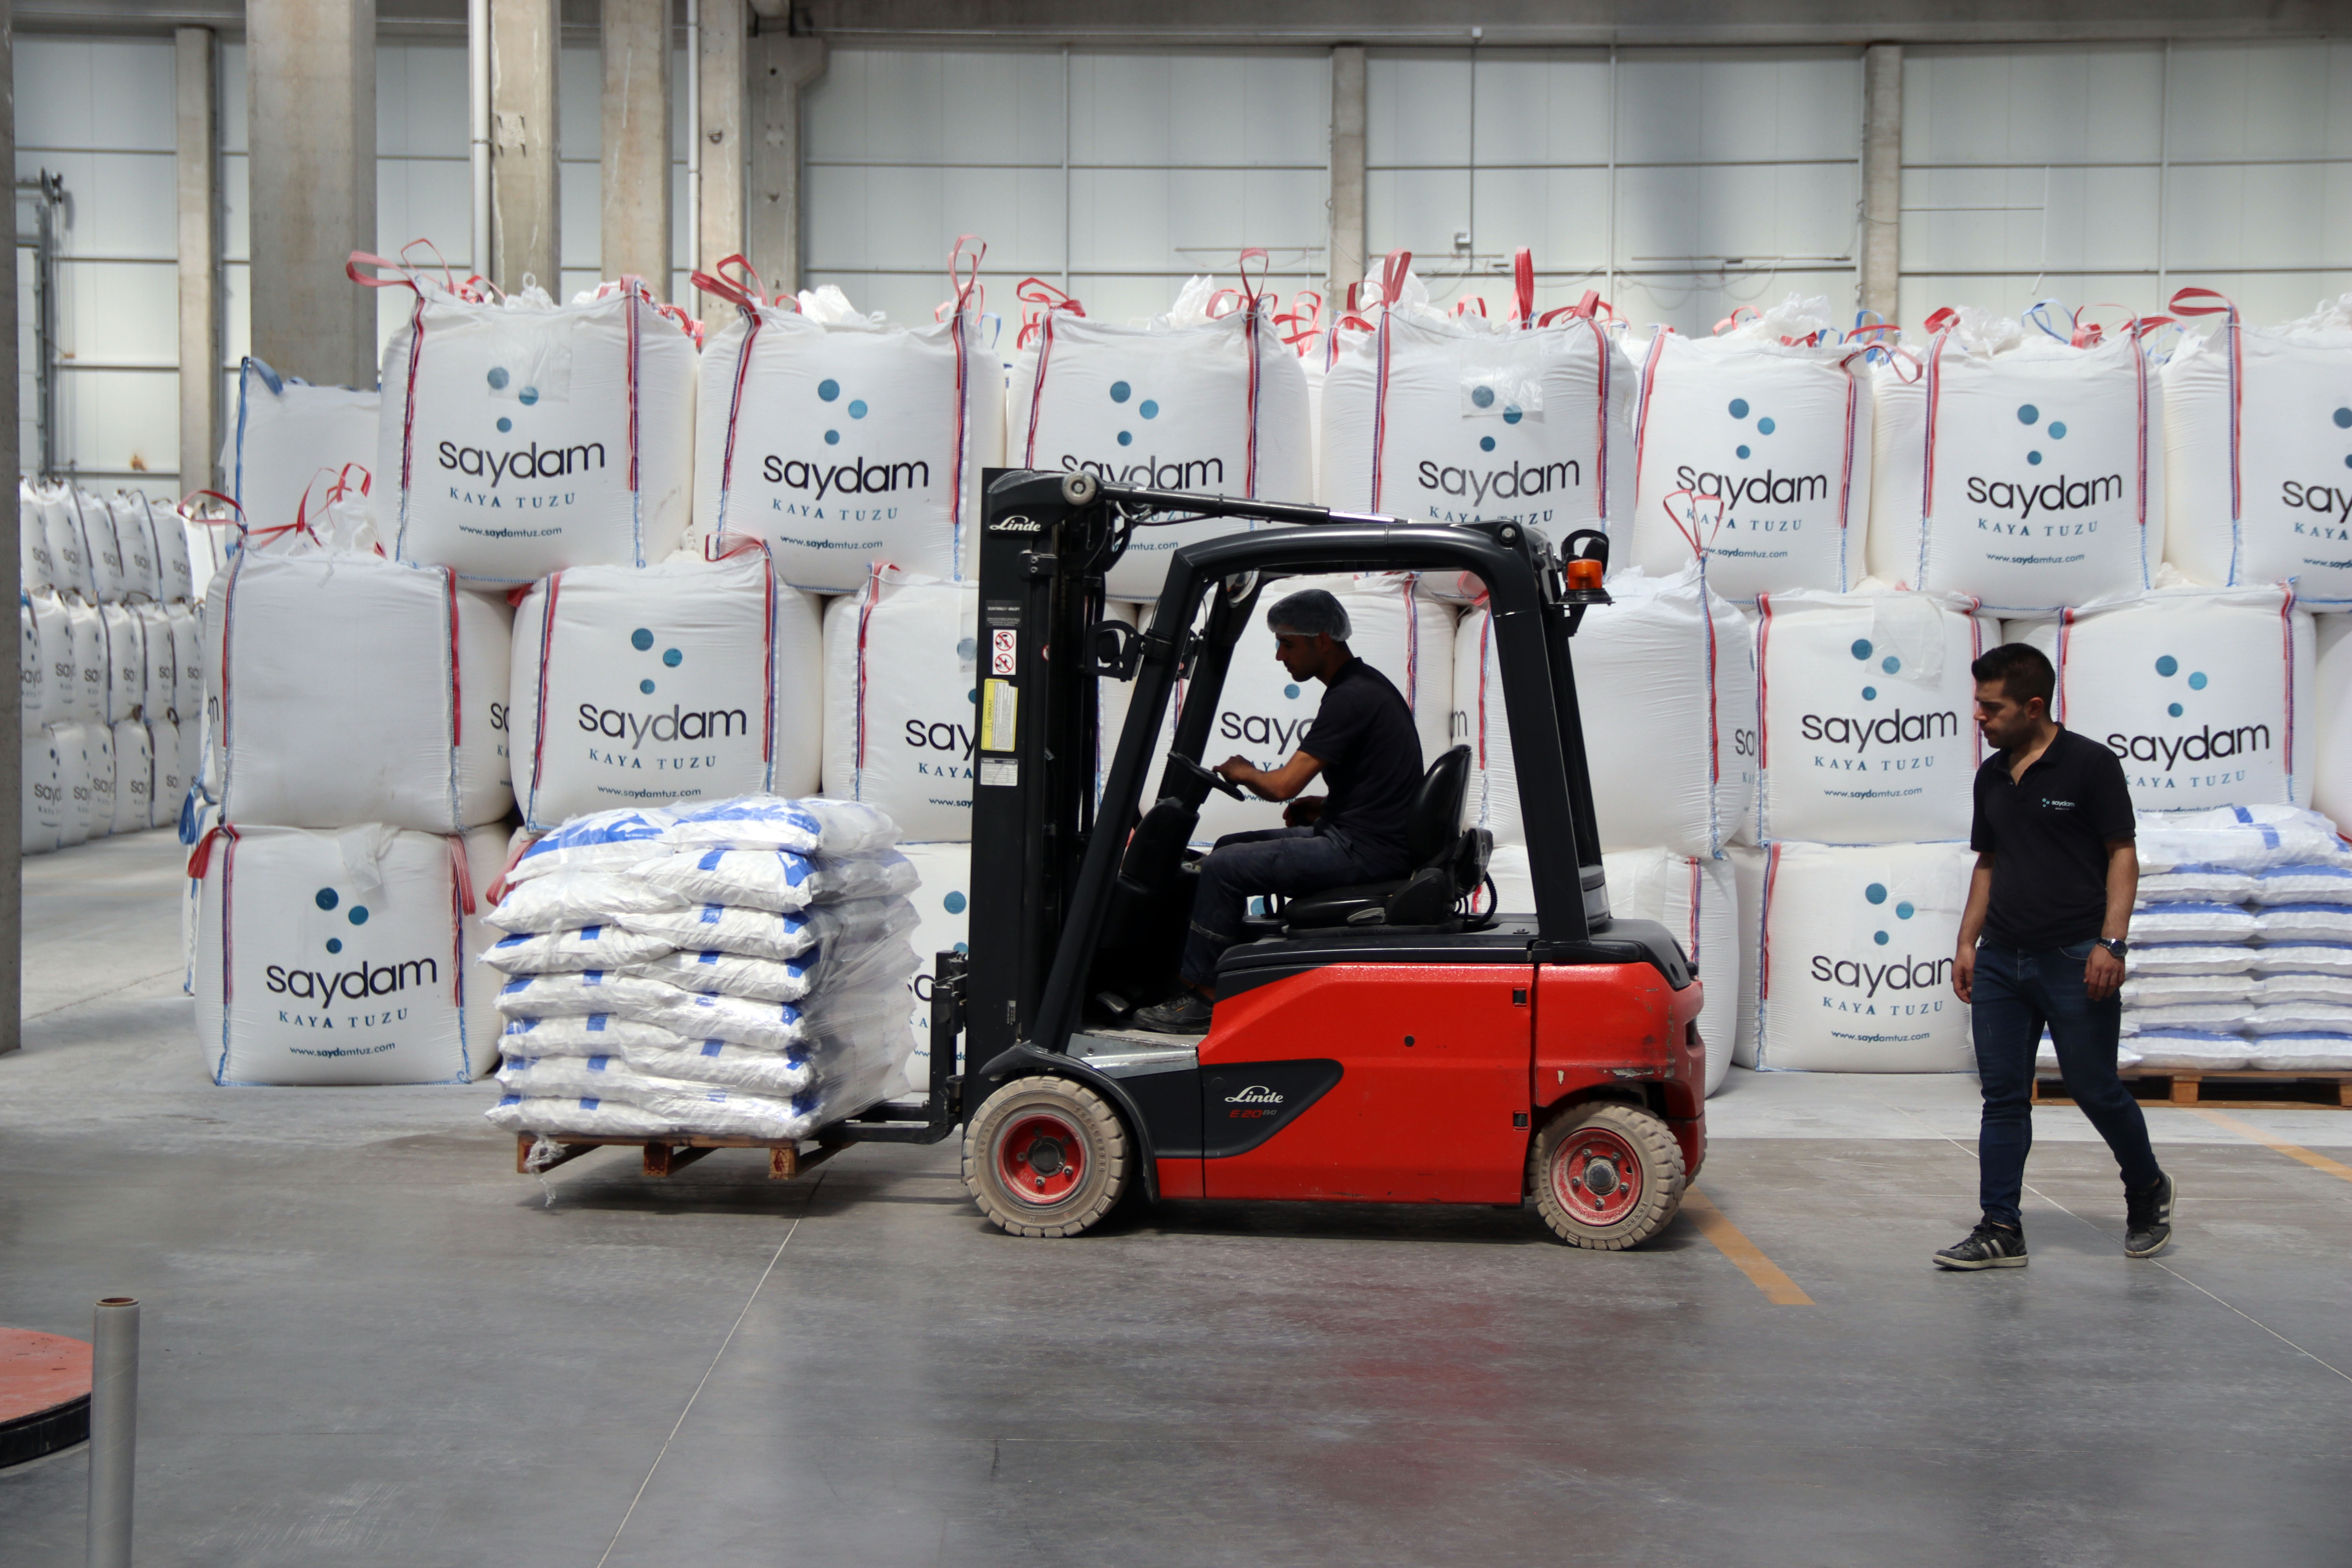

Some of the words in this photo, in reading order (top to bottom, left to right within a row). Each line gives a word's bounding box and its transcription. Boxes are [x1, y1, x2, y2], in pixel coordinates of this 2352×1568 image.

[439, 441, 605, 488] saydam
[763, 455, 929, 501] saydam
[1418, 460, 1579, 507] saydam
[1677, 466, 1827, 510] saydam
[450, 486, 501, 508] KAYA
[516, 493, 575, 508] TUZU
[1967, 474, 2122, 519] saydam
[2282, 481, 2352, 524] say
[773, 498, 824, 519] KAYA
[840, 508, 898, 521] TUZU
[1429, 506, 1481, 523] KAYA
[1686, 508, 1736, 529] KAYA
[1750, 520, 1801, 531] TUZU
[459, 524, 562, 539] www.saydamtuz.com
[989, 515, 1041, 532] Linde
[1978, 518, 2030, 536] KAYA
[2045, 521, 2098, 537] TUZU
[2294, 522, 2348, 541] KAYA
[780, 535, 883, 549] www.saydamtuz.com
[1697, 546, 1788, 558] ww.saydamtuz.com
[1986, 553, 2085, 565] www.saydamtuz.com
[579, 703, 746, 750] saydam
[1220, 711, 1316, 755] say
[1802, 709, 1957, 753] saydam
[906, 719, 975, 760] say
[2107, 724, 2269, 771] saydam
[589, 748, 642, 769] KAYA
[657, 756, 717, 769] TUZU
[1814, 756, 1867, 771] KAYA
[1882, 756, 1934, 771] TUZU
[919, 762, 973, 779] KAYA
[2190, 770, 2245, 788] TUZU
[597, 785, 701, 799] www.saydamtuz.com
[1824, 787, 1922, 800] www.saydamtuz.com
[267, 958, 437, 1009] saydam
[1823, 996, 1876, 1015] KAYA
[1891, 1000, 1943, 1016] TUZU
[279, 1010, 334, 1029] KAYA
[348, 1008, 408, 1028] TUZU
[1831, 1031, 1930, 1043] www.saydamtuz.com
[289, 1042, 396, 1058] www.saydamtuz.com
[1225, 1085, 1284, 1103] Linde
